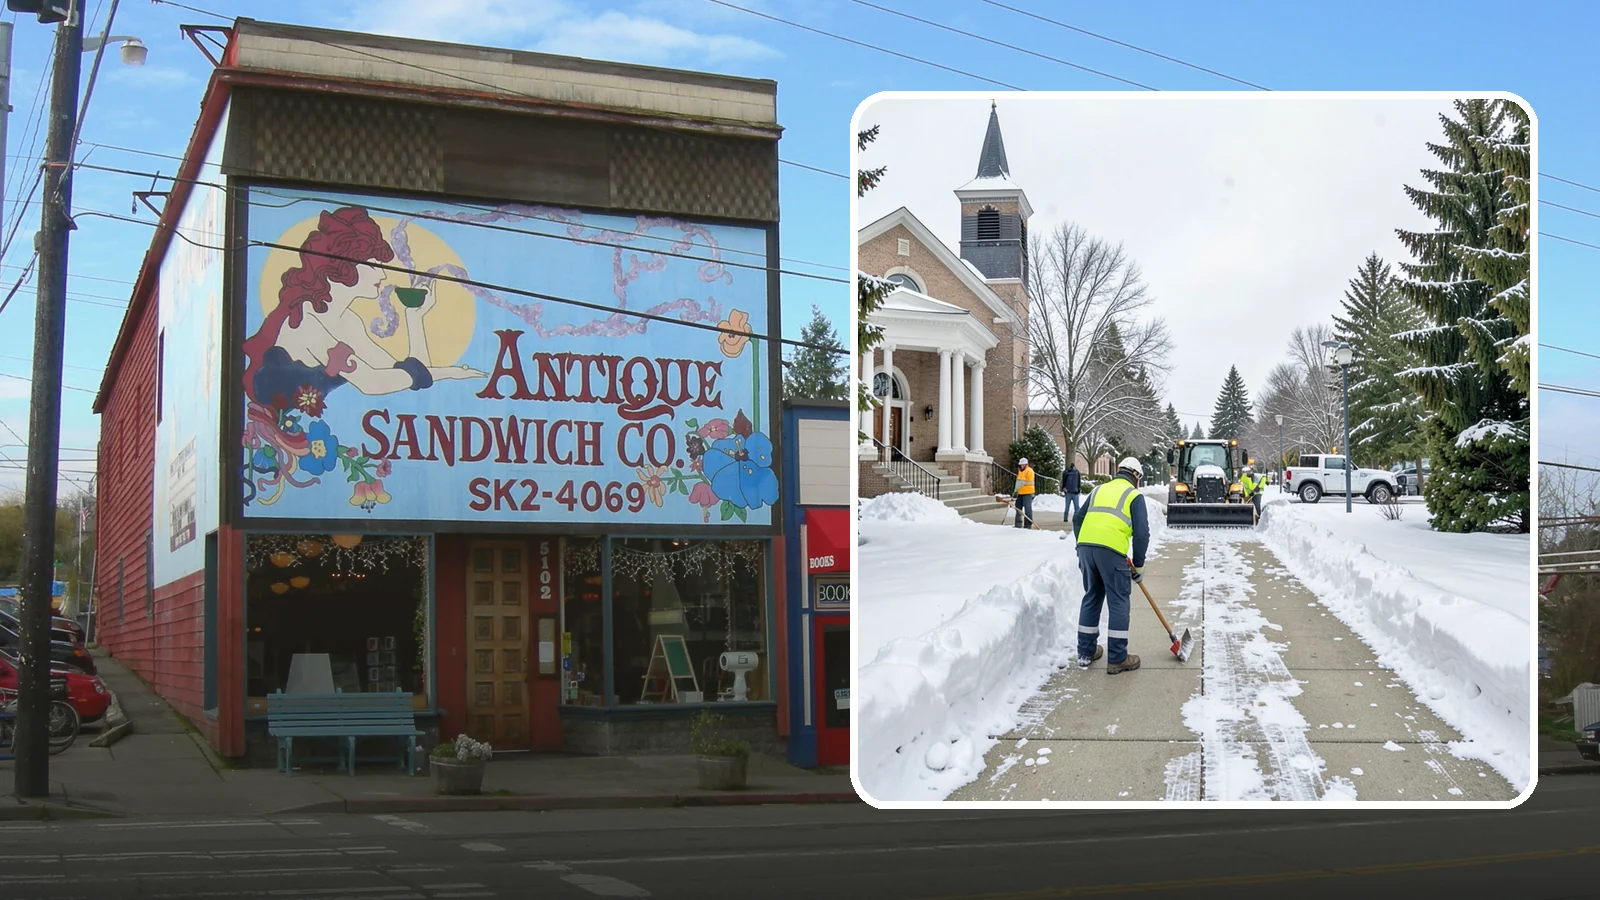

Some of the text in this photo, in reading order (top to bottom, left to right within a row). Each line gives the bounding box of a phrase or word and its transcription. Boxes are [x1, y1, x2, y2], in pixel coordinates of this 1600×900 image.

[476, 329, 724, 421] ANTIQUE
[361, 408, 684, 468] SANDWICH CO.
[468, 477, 646, 513] SK2-4069
[539, 541, 553, 600] 5102
[809, 555, 835, 569] BOOKS
